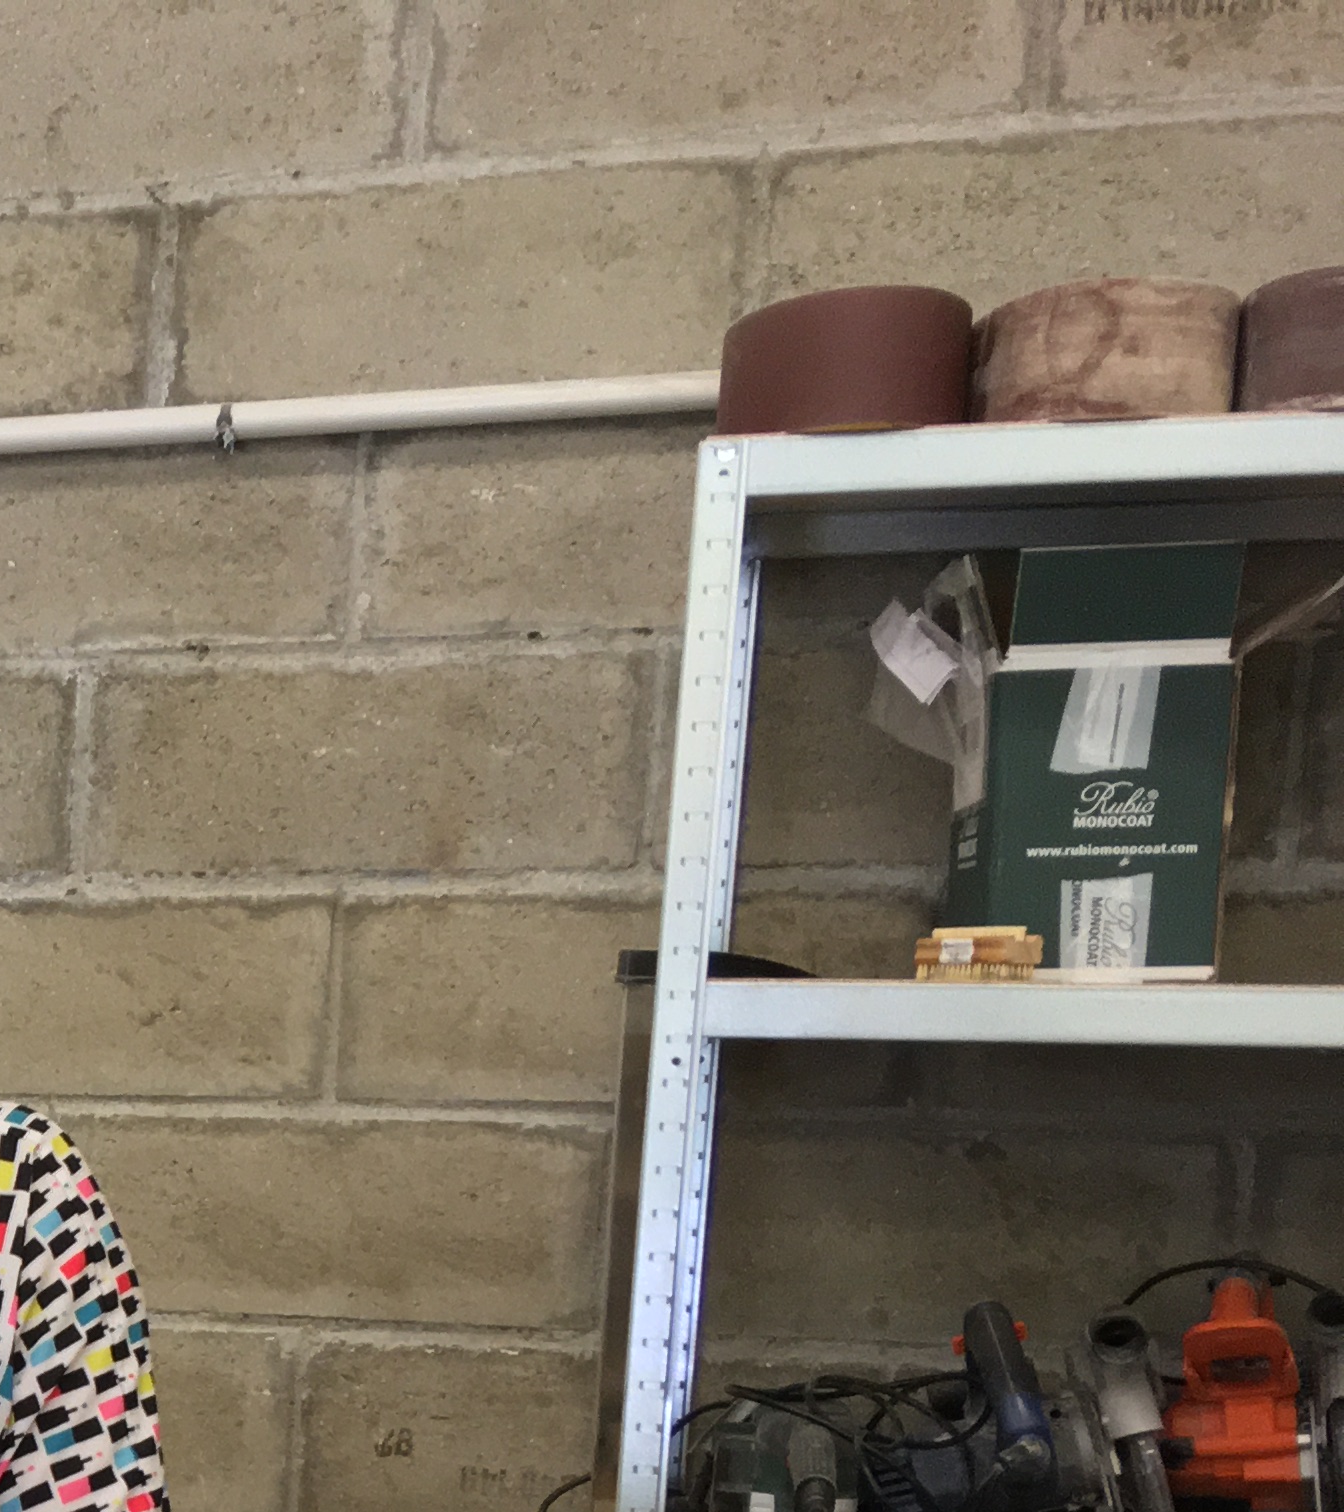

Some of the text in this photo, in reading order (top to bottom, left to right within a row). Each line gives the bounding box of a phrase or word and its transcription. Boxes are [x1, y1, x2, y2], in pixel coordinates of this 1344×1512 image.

[1073, 781, 1158, 815] Rubio
[1072, 813, 1154, 829] MONOCOAT
[1026, 842, 1199, 858] www.rubiomonocoat.com
